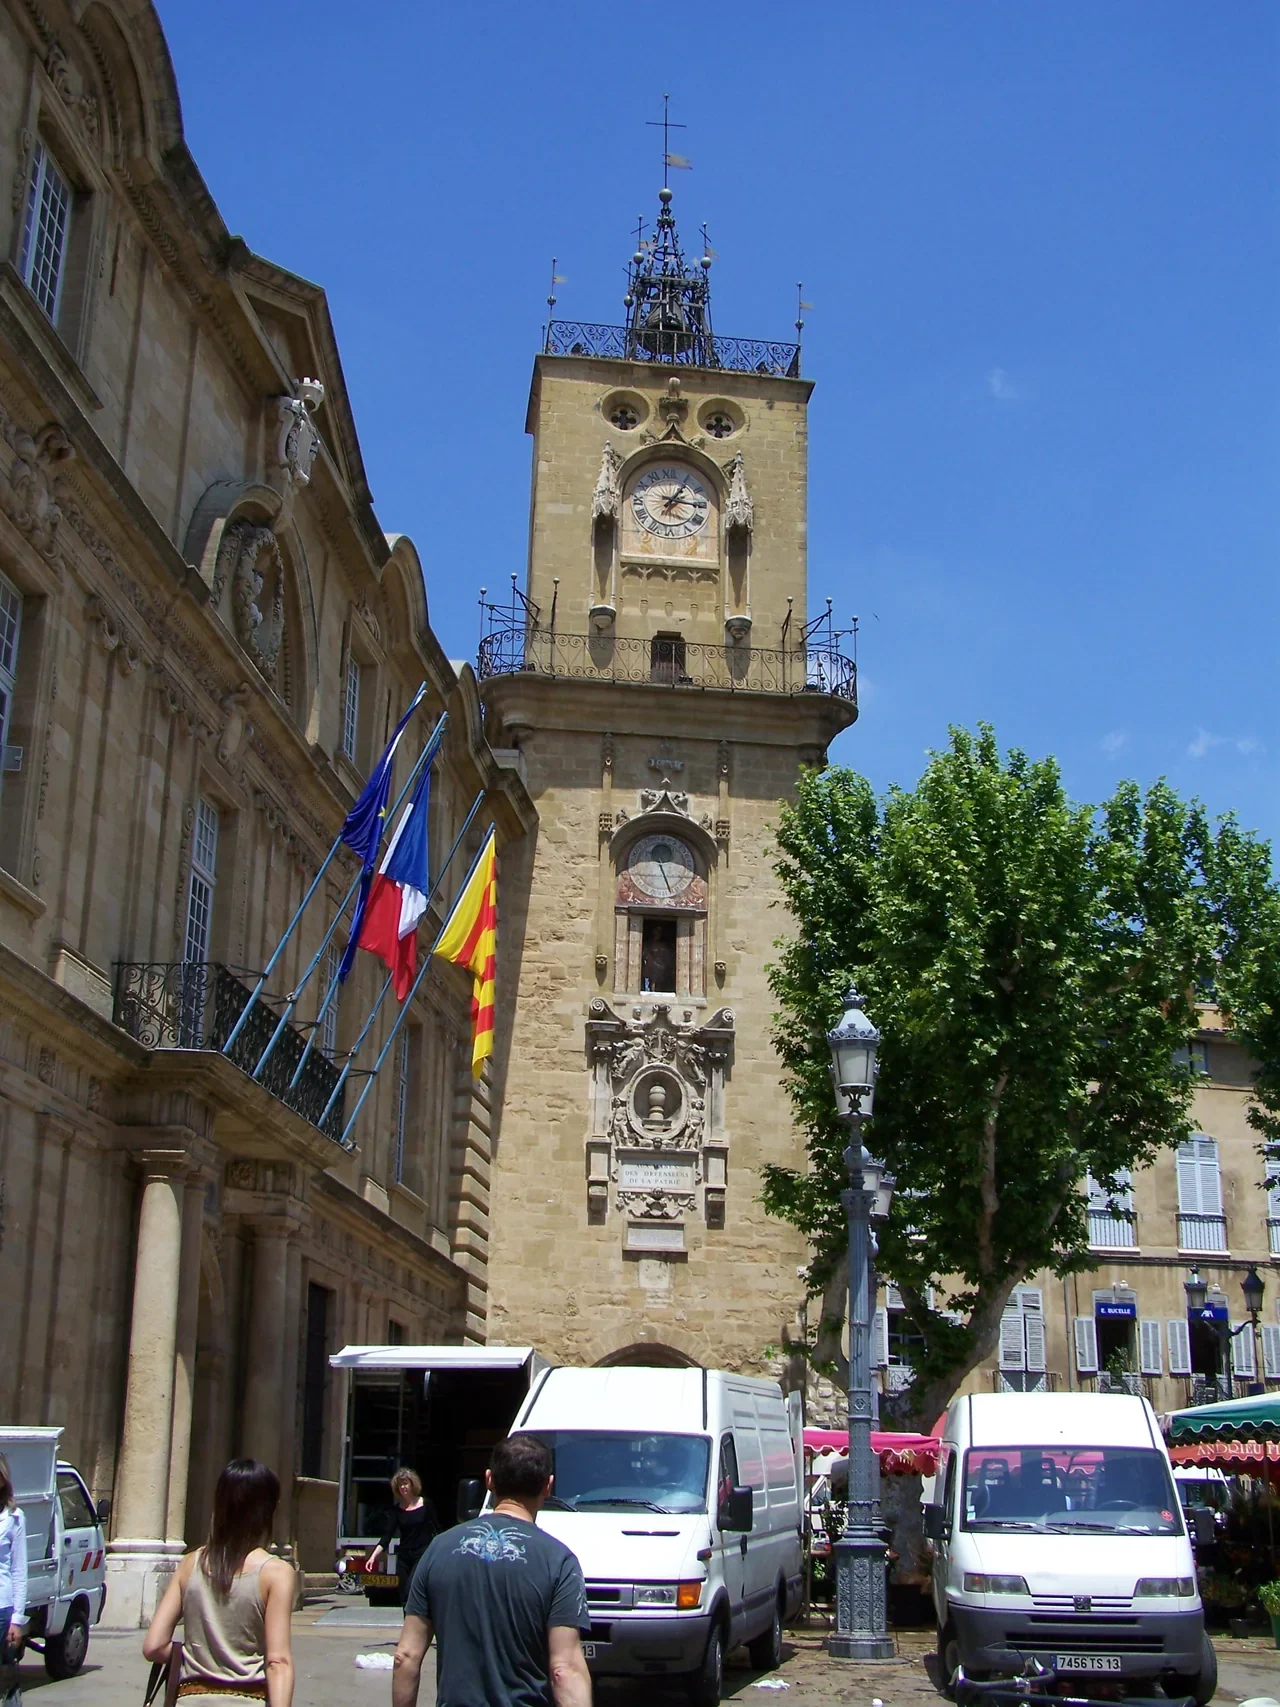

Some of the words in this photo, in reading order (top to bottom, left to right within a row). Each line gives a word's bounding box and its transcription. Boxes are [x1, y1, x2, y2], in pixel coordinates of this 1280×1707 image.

[1197, 1442, 1261, 1456] ANDRIEU
[582, 1644, 594, 1657] 13
[1059, 1657, 1088, 1669] 7456
[1089, 1658, 1103, 1669] TS
[1107, 1658, 1120, 1669] 13
